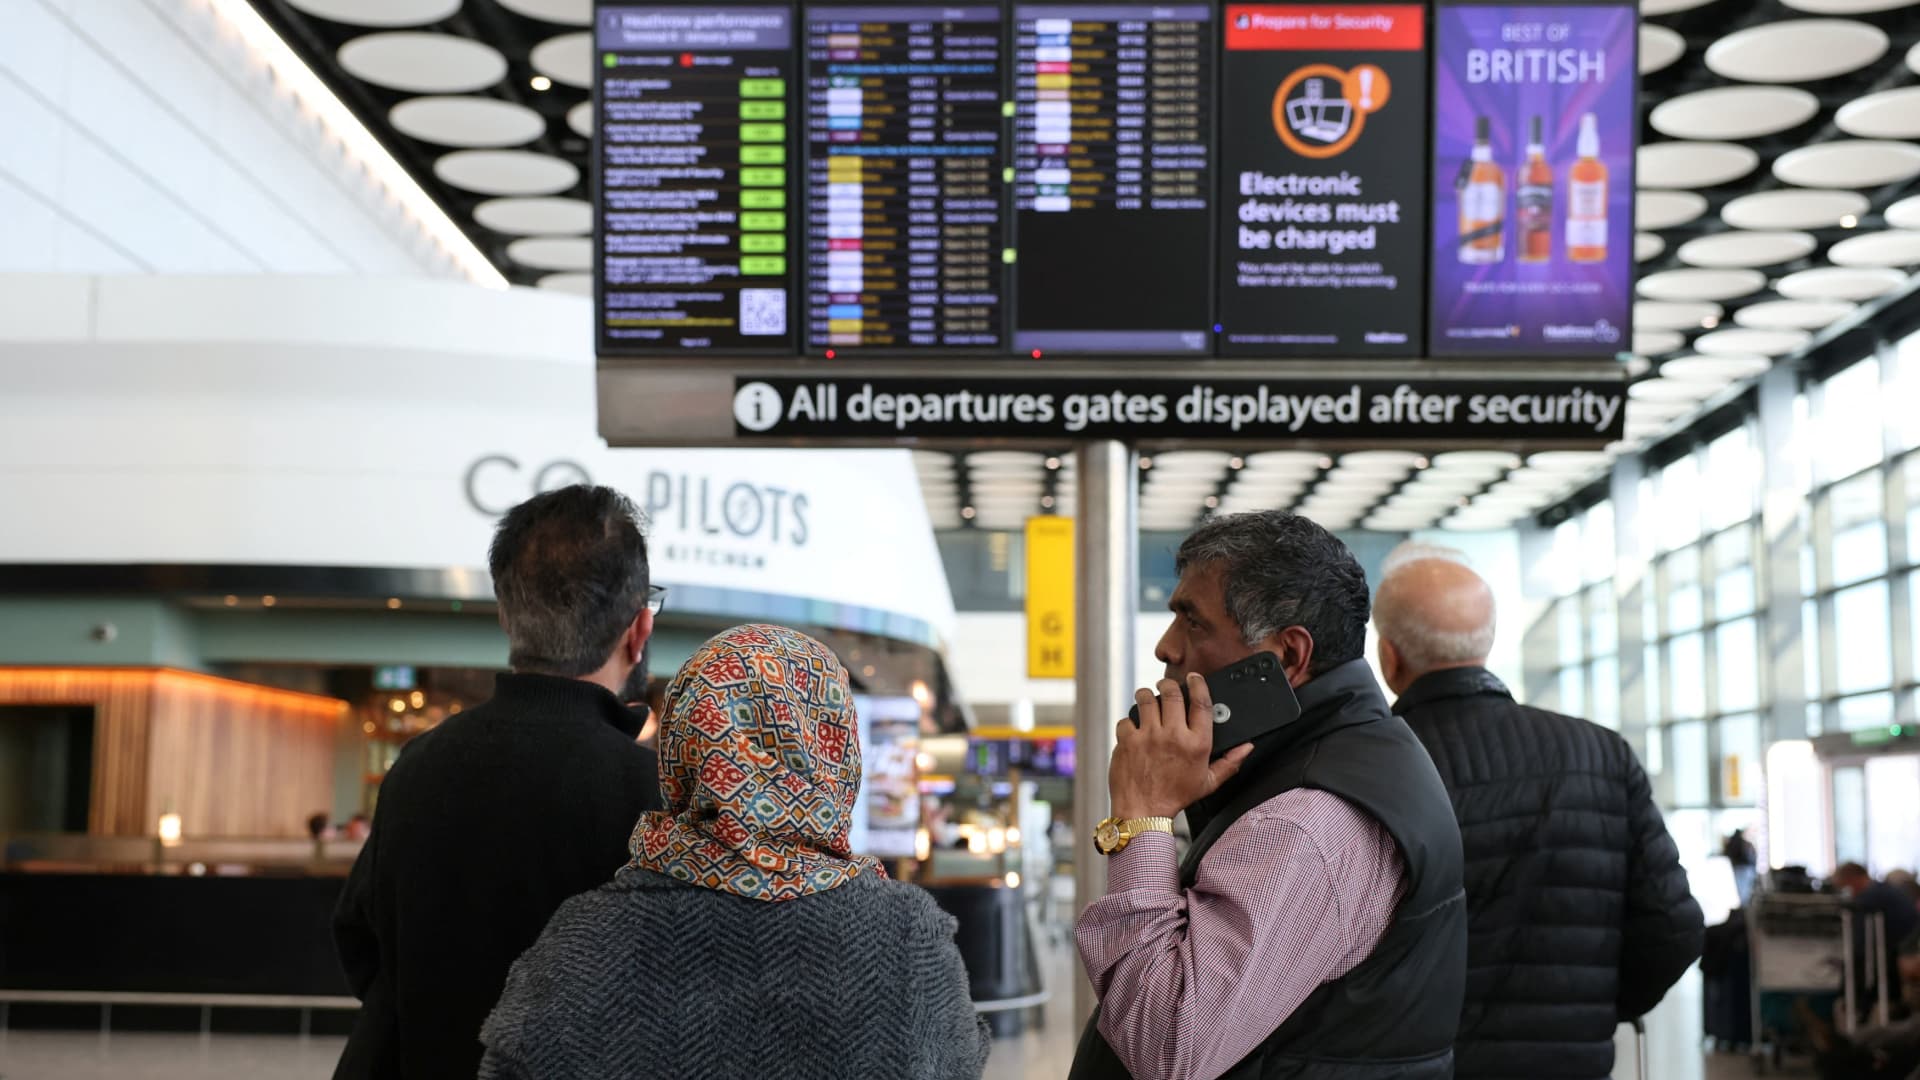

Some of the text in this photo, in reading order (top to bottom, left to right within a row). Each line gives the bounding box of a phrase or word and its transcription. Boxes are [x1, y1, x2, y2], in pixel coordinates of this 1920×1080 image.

[622, 14, 783, 30] Heathrow performance
[1251, 13, 1393, 32] Prepare for Security
[1502, 23, 1570, 41] BEST OF
[1466, 48, 1605, 84] BRITISH
[1239, 171, 1362, 196] Electronic
[1238, 198, 1400, 223] devices must
[1238, 225, 1376, 254] be charged
[788, 384, 1620, 432] All departures gates displayed after security
[648, 470, 810, 547] PILOTS
[664, 544, 767, 570] KITCHEN
